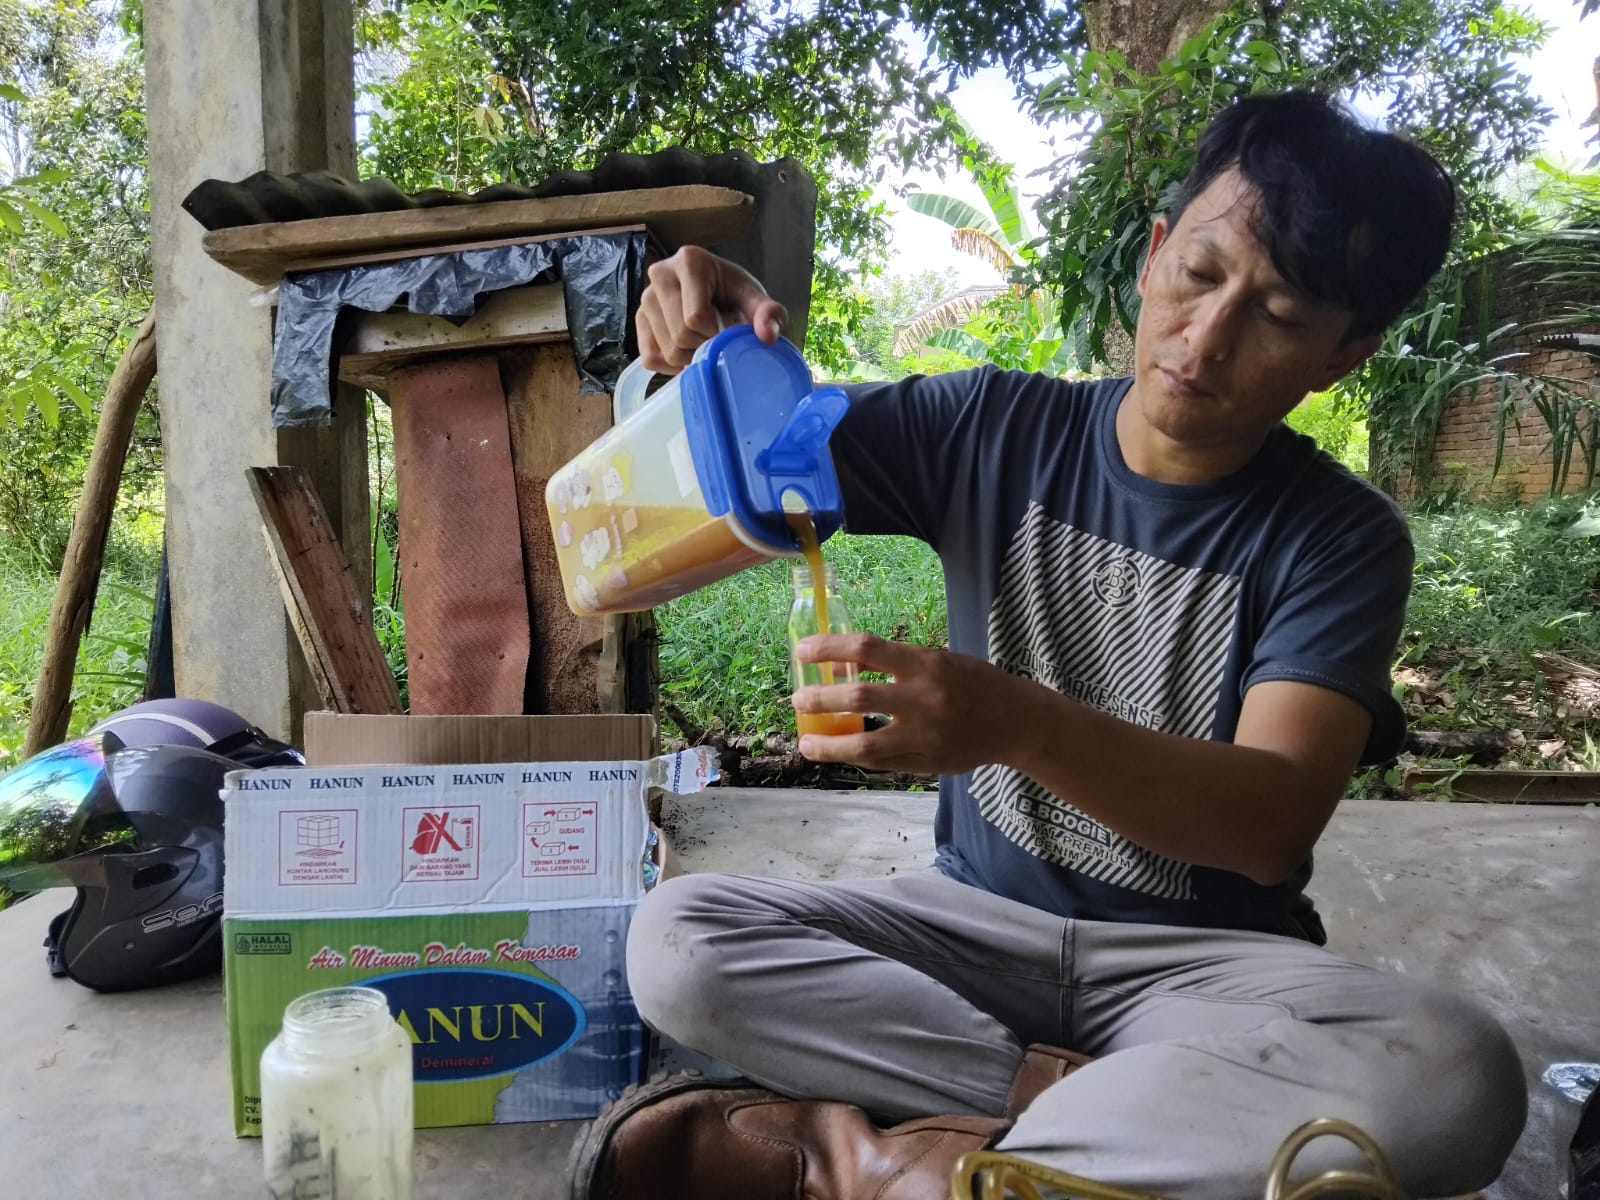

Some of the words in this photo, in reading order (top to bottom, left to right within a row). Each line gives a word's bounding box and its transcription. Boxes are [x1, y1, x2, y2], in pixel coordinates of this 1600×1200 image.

[1112, 695, 1162, 729] SENSE
[238, 778, 292, 791] HANUN
[310, 777, 364, 790] HANUN
[381, 775, 435, 788] HANUN
[452, 773, 505, 785] HANUN
[522, 771, 572, 783] HANUN
[589, 769, 638, 781] HANUN
[1018, 797, 1108, 844] B.BOOGIE
[1003, 809, 1057, 842] RIGINAL
[1063, 835, 1131, 869] PREMIUM
[1034, 837, 1080, 862] DENIM
[251, 936, 289, 945] HALAL
[307, 946, 345, 970] Air
[350, 945, 419, 969] Minum
[424, 942, 490, 966] Dalam
[496, 939, 581, 963] Kemasan
[395, 1002, 547, 1045] ANUN
[421, 1056, 494, 1069] Demineral
